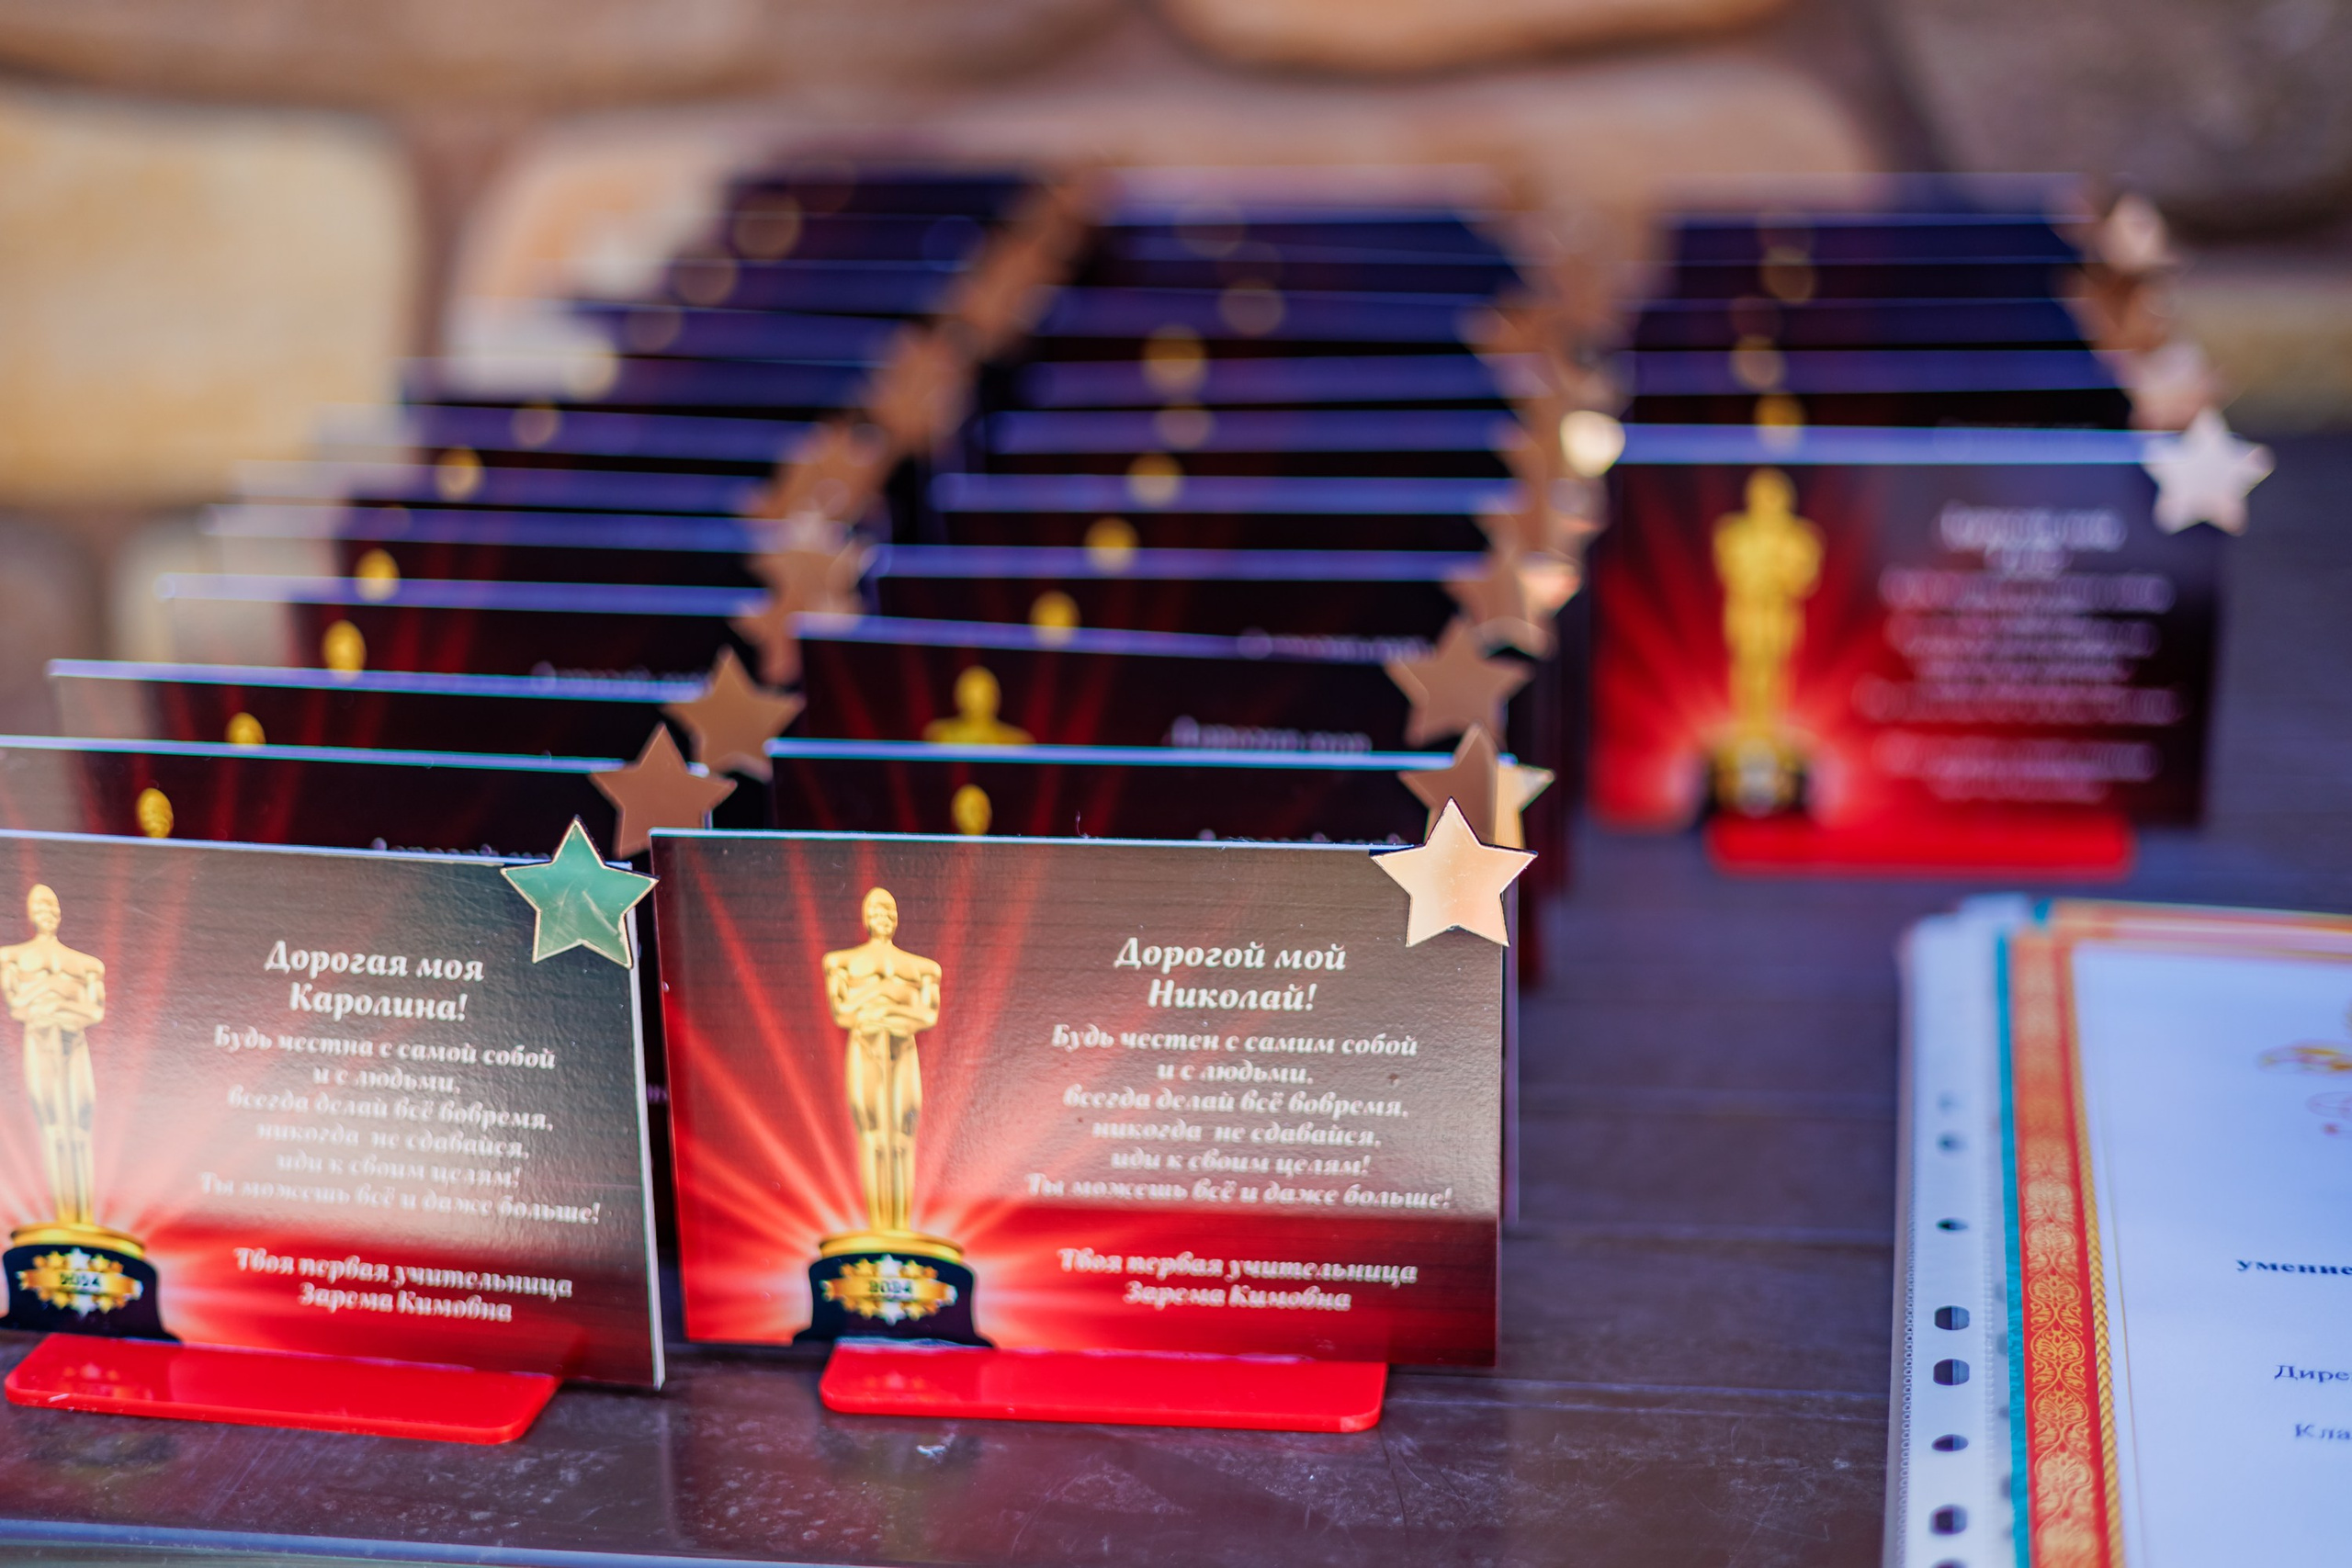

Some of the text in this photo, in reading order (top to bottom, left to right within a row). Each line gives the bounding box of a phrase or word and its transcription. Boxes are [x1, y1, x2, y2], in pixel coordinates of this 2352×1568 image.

[264, 940, 484, 981] Дорогая моя
[1114, 937, 1347, 975] Дорогой мой
[289, 981, 468, 1021] Каролина!
[1148, 978, 1317, 1011] Николай!
[213, 1023, 556, 1069] Будь честна с самой собой
[1052, 1022, 1418, 1056] Будь честен с самим собой
[312, 1066, 329, 1084] и
[335, 1068, 348, 1085] с
[1158, 1062, 1174, 1079] и
[1181, 1063, 1195, 1080] с
[1063, 1084, 1150, 1111] всегда
[1156, 1086, 1234, 1112] делай
[1239, 1088, 1283, 1113] всё
[1092, 1118, 1202, 1143] никогда
[1215, 1124, 1246, 1143] не
[1111, 1146, 1370, 1179] иди к своим целям!
[1025, 1173, 1453, 1209] Ты можешь всё и даже больше!
[1057, 1247, 1419, 1290] Твоя первая учительница
[2235, 1259, 2352, 1276] умение
[1124, 1280, 1351, 1312] Зарема Кимовна
[2274, 1364, 2352, 1382] Дире
[2295, 1423, 2352, 1440] Кла
